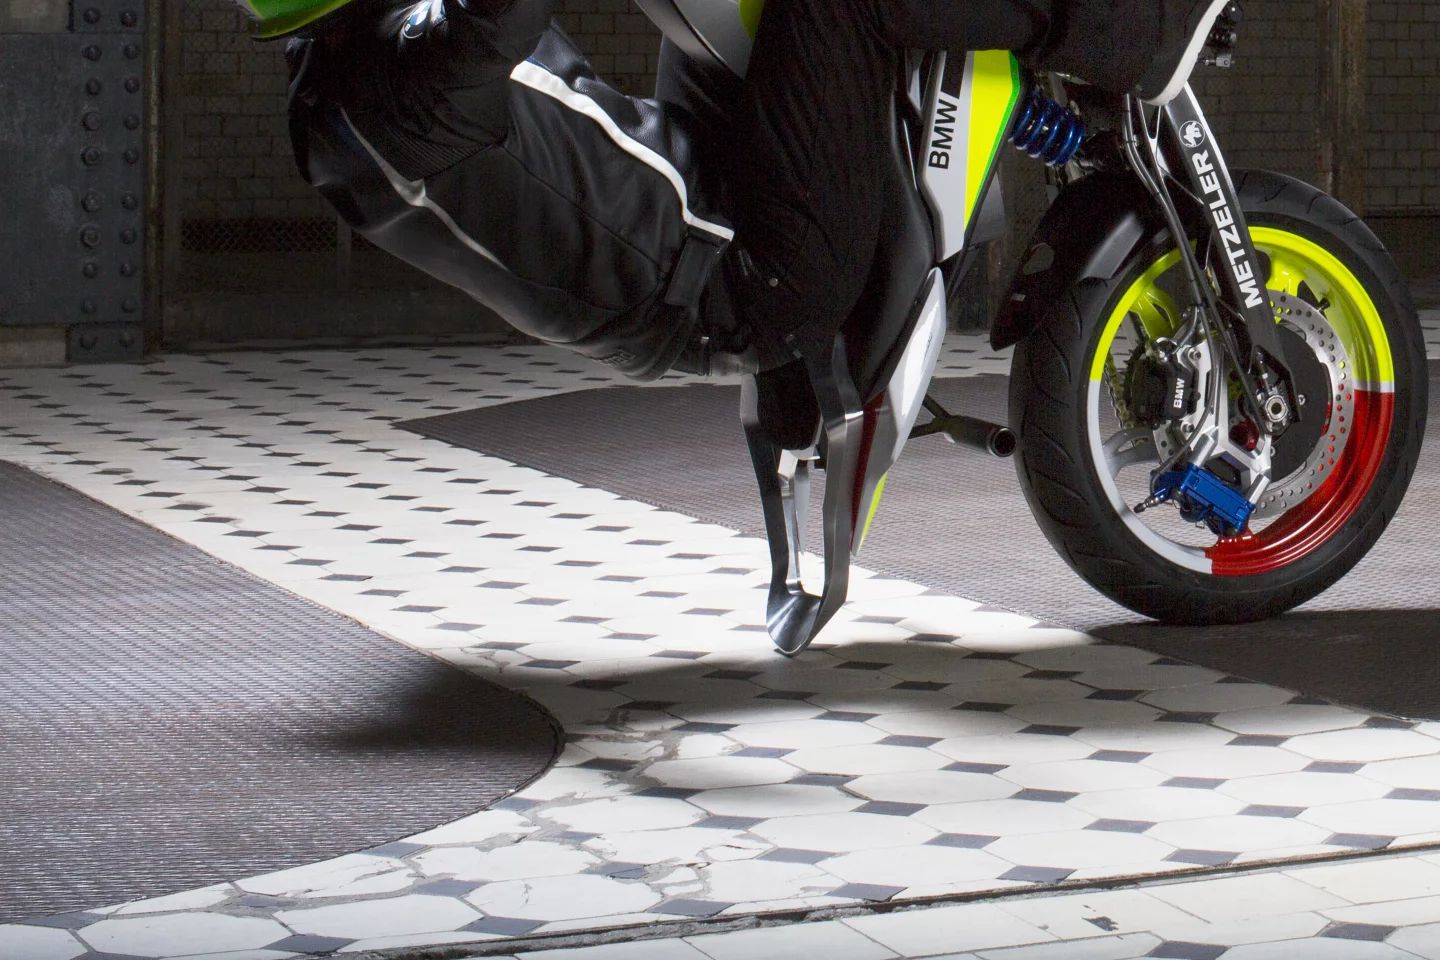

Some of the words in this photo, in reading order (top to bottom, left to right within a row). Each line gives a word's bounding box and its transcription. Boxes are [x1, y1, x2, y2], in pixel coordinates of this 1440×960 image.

[928, 98, 958, 169] BMW
[1191, 149, 1263, 309] METZELER
[1173, 377, 1185, 409] BMW
